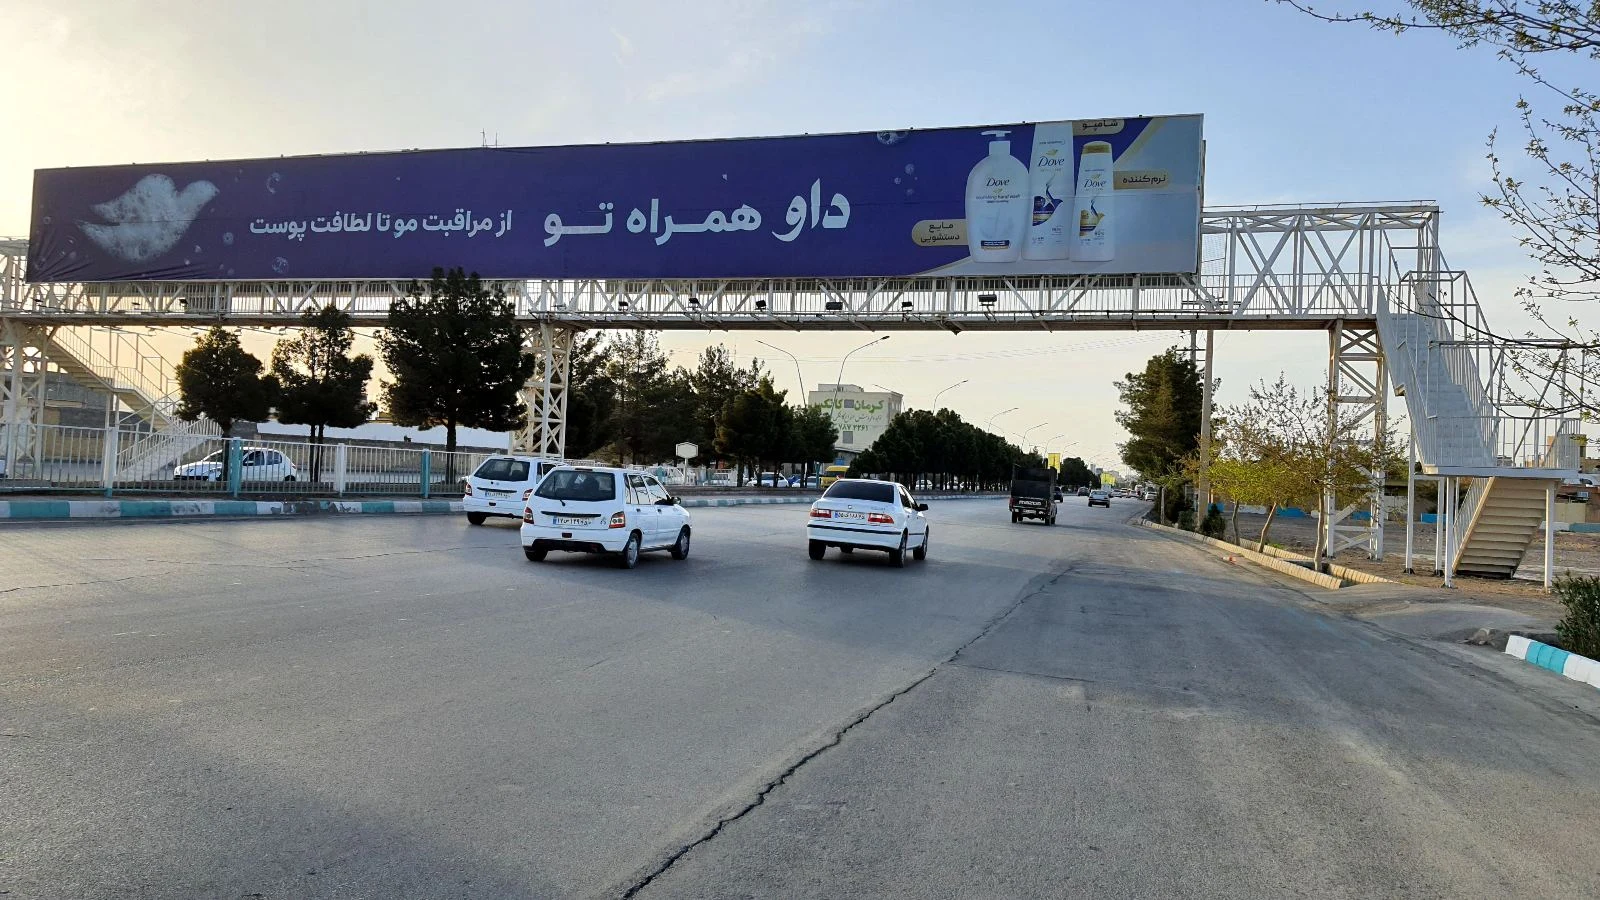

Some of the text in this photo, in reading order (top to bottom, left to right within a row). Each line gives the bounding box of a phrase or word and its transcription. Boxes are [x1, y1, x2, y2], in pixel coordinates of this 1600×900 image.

[1038, 155, 1065, 167] Dove
[986, 177, 1010, 187] Dove
[1083, 179, 1107, 188] Dove
[543, 178, 851, 247] داو همراه تو
[249, 208, 513, 241] از مراقبت مو تا لطافت پوست
[929, 222, 954, 233] مایع
[854, 399, 884, 414] کرمان
